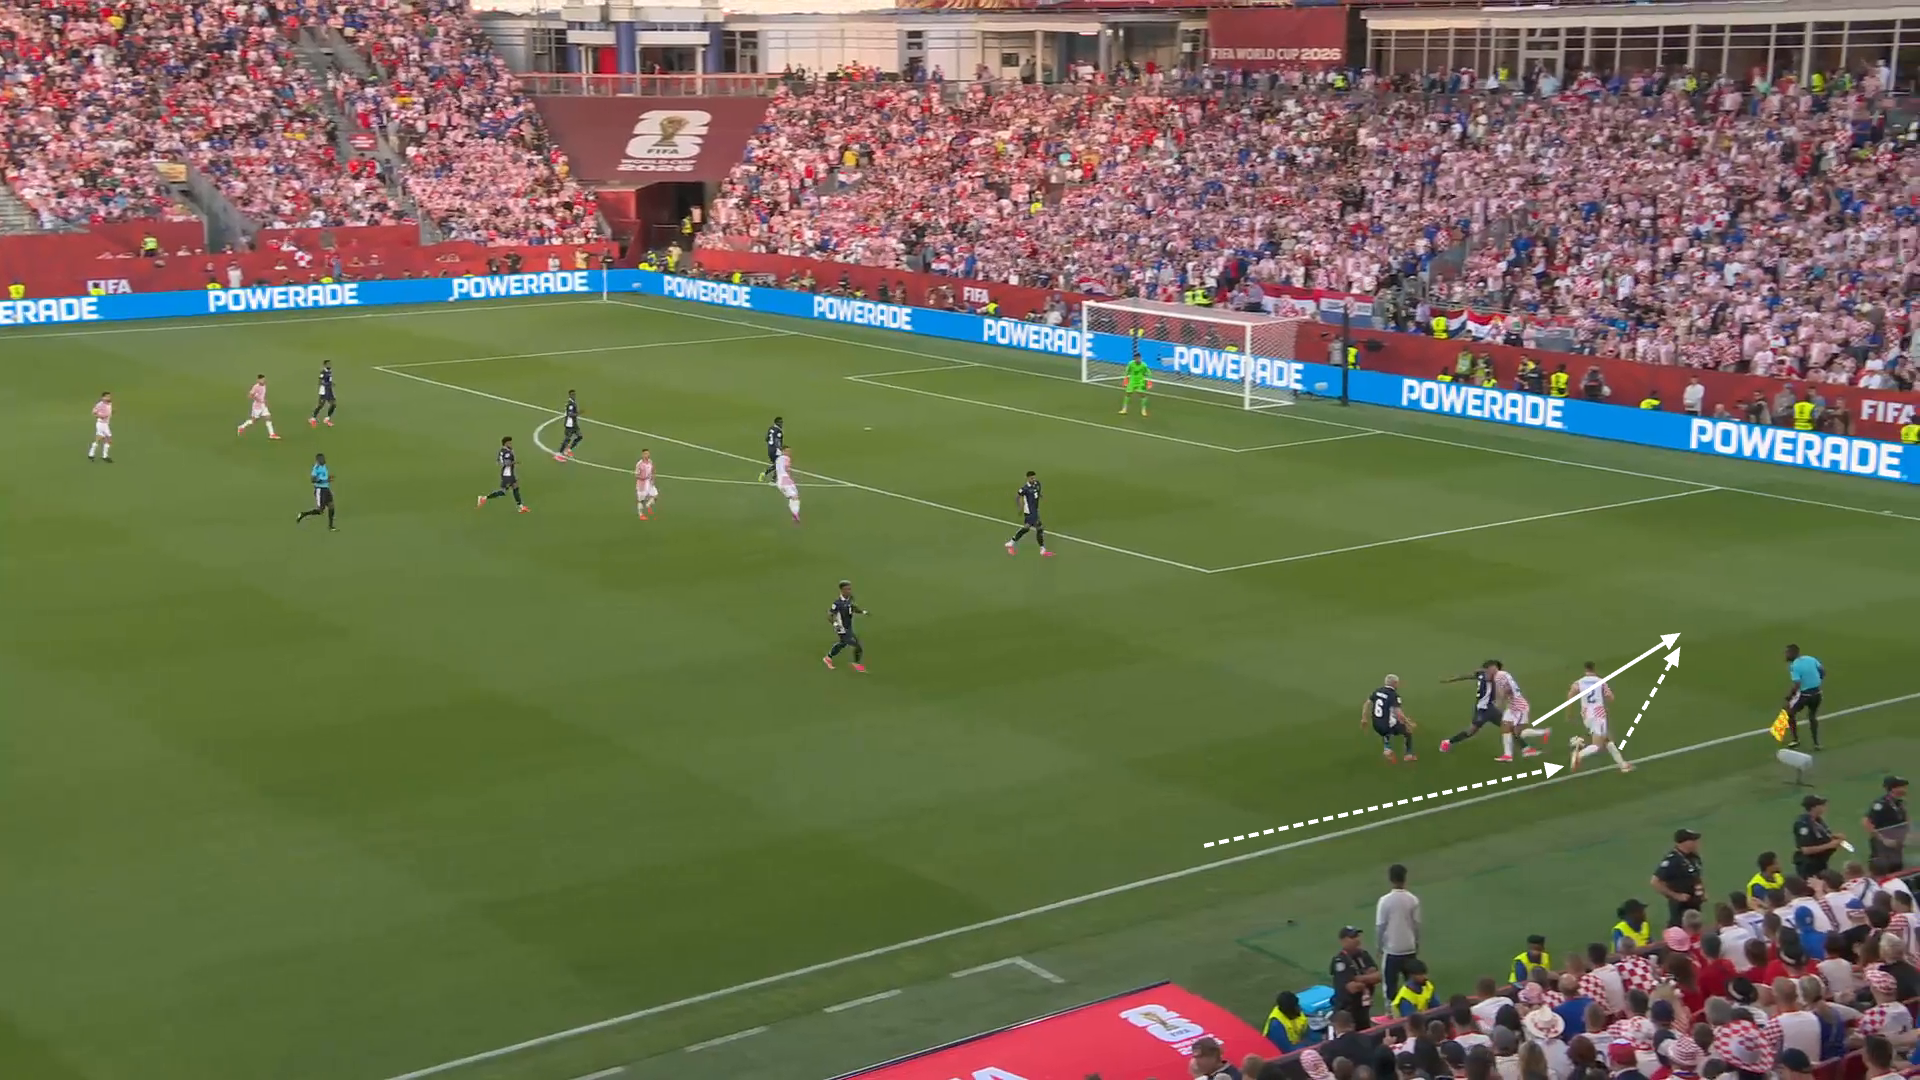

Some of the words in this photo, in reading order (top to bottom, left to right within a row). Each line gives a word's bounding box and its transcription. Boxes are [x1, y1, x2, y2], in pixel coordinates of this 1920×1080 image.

[1211, 48, 1235, 59] FIFA
[1236, 48, 1275, 60] WORLD
[1276, 48, 1300, 60] CUP
[1300, 48, 1342, 60] 2026
[207, 283, 359, 313] POWERADE
[452, 271, 589, 299] POWERADE
[663, 275, 753, 307] POWERADE
[963, 286, 990, 303] FIFA
[813, 295, 912, 330] POWERADE
[983, 318, 1094, 358] POWERADE
[1173, 346, 1304, 390] POWERADE
[1401, 378, 1566, 429] POWERADE
[1860, 399, 1917, 424] FIFA
[1690, 418, 1904, 478] POWERADE
[1374, 699, 1384, 718] 6
[1586, 687, 1597, 704] 2
